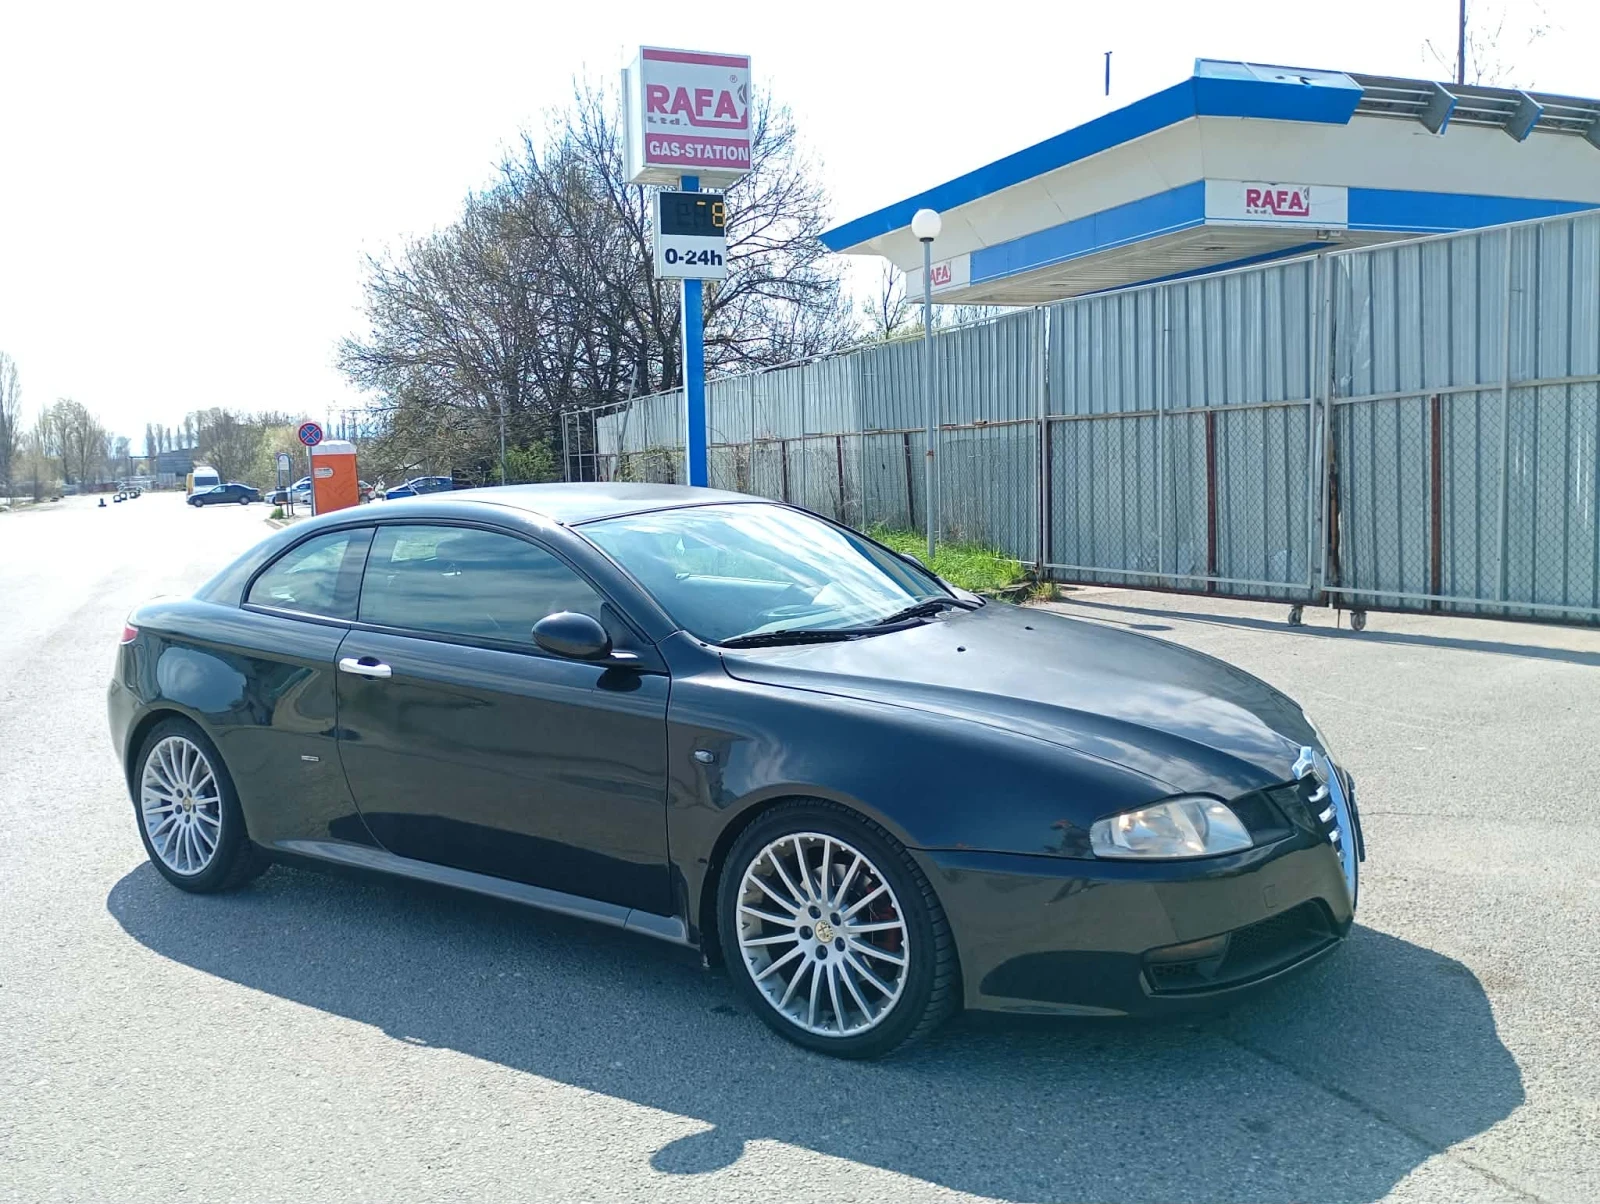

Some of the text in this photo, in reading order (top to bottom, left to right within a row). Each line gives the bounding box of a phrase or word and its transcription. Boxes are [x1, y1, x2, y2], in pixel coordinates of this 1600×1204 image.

[646, 84, 739, 120] RAFA
[649, 140, 749, 161] GAS-STATION
[1246, 188, 1303, 210] RAFA
[665, 248, 722, 266] 0-24h
[923, 265, 949, 286] AFA
